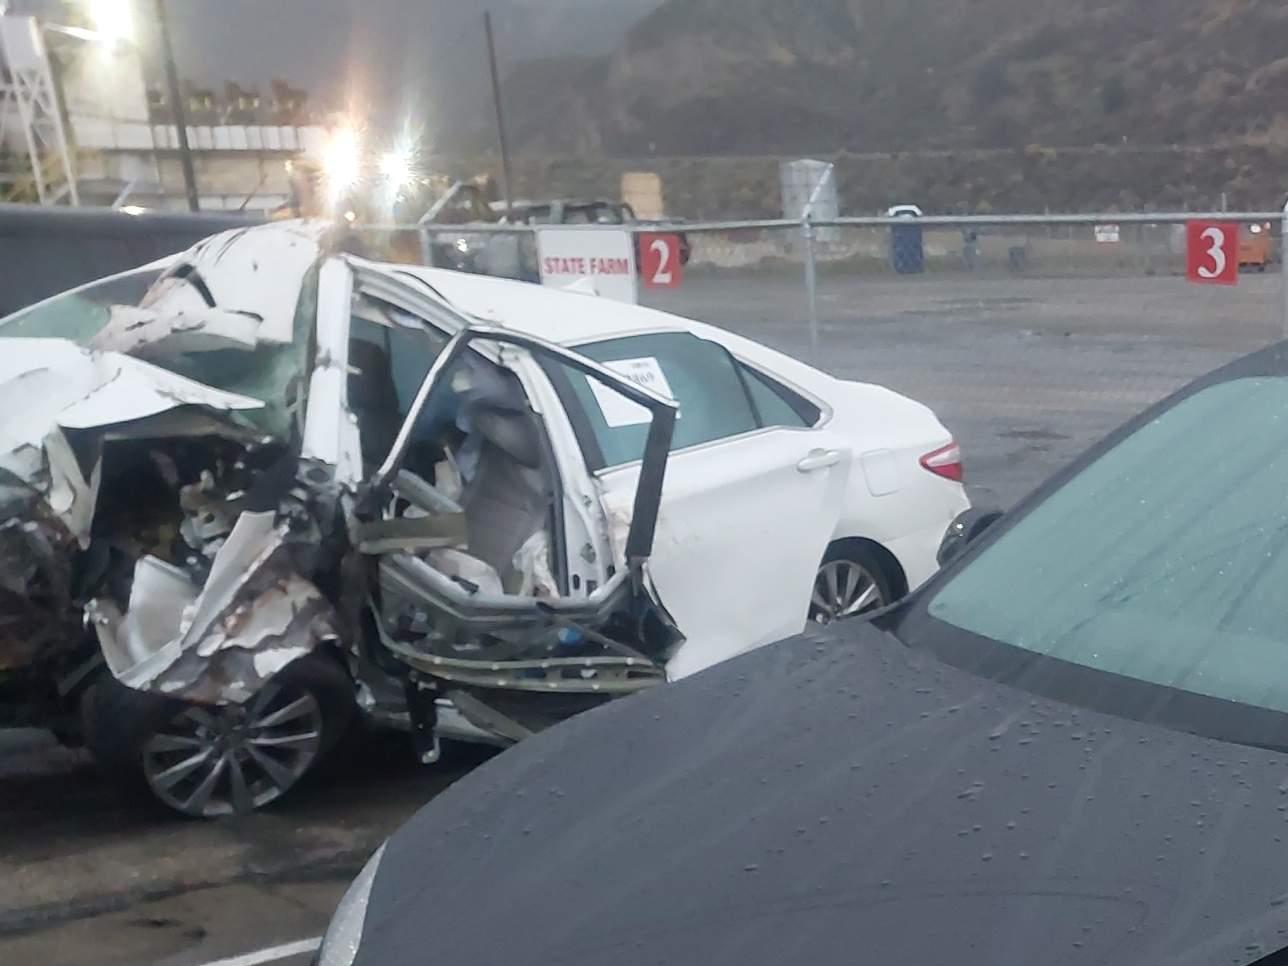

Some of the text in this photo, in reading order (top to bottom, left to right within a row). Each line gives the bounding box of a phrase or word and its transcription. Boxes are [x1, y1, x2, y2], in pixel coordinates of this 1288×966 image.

[543, 257, 629, 275] STATE FARM
[649, 239, 673, 284] 2
[1197, 227, 1226, 278] 3
